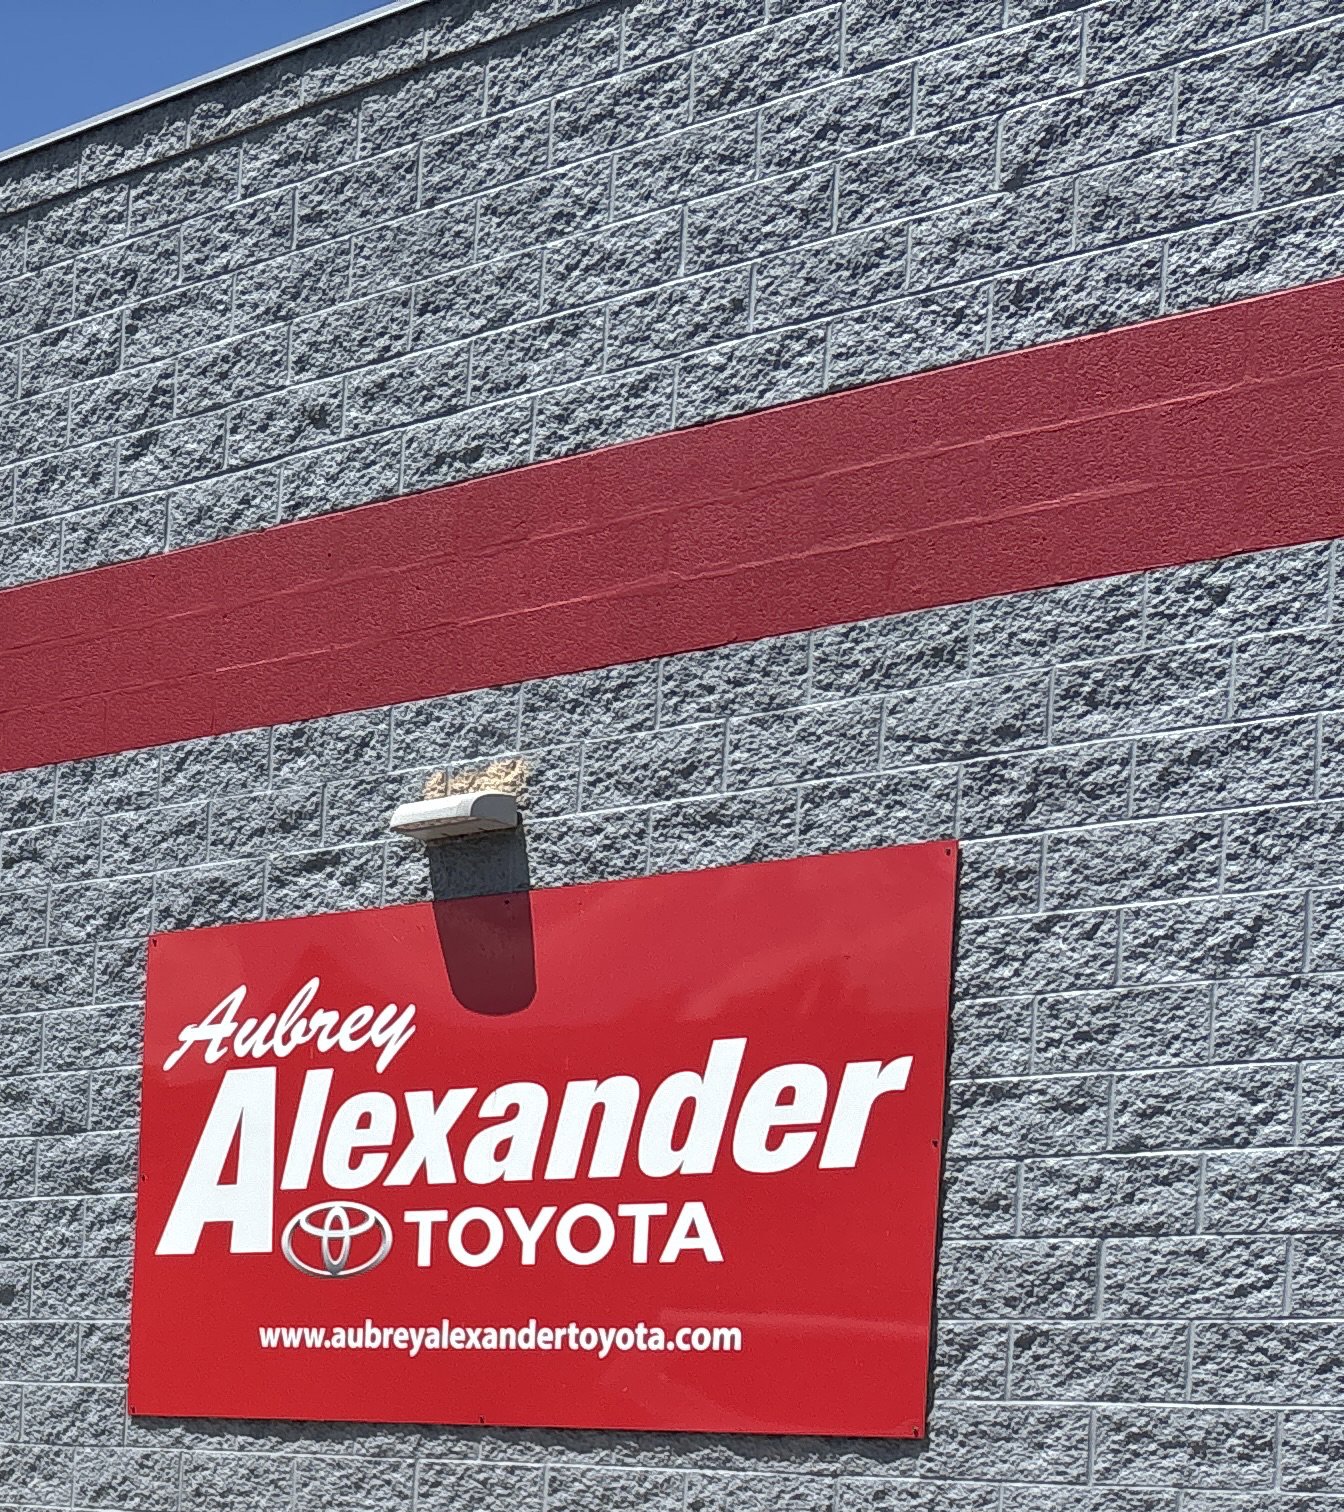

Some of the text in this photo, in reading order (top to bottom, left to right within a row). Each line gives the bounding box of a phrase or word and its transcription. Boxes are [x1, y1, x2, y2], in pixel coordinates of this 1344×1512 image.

[163, 976, 416, 1074] Aubrey
[154, 1037, 914, 1255] Alexander
[403, 1201, 724, 1268] TOYOTA
[258, 1318, 742, 1359] www.aubreyalexandertoyota.com
